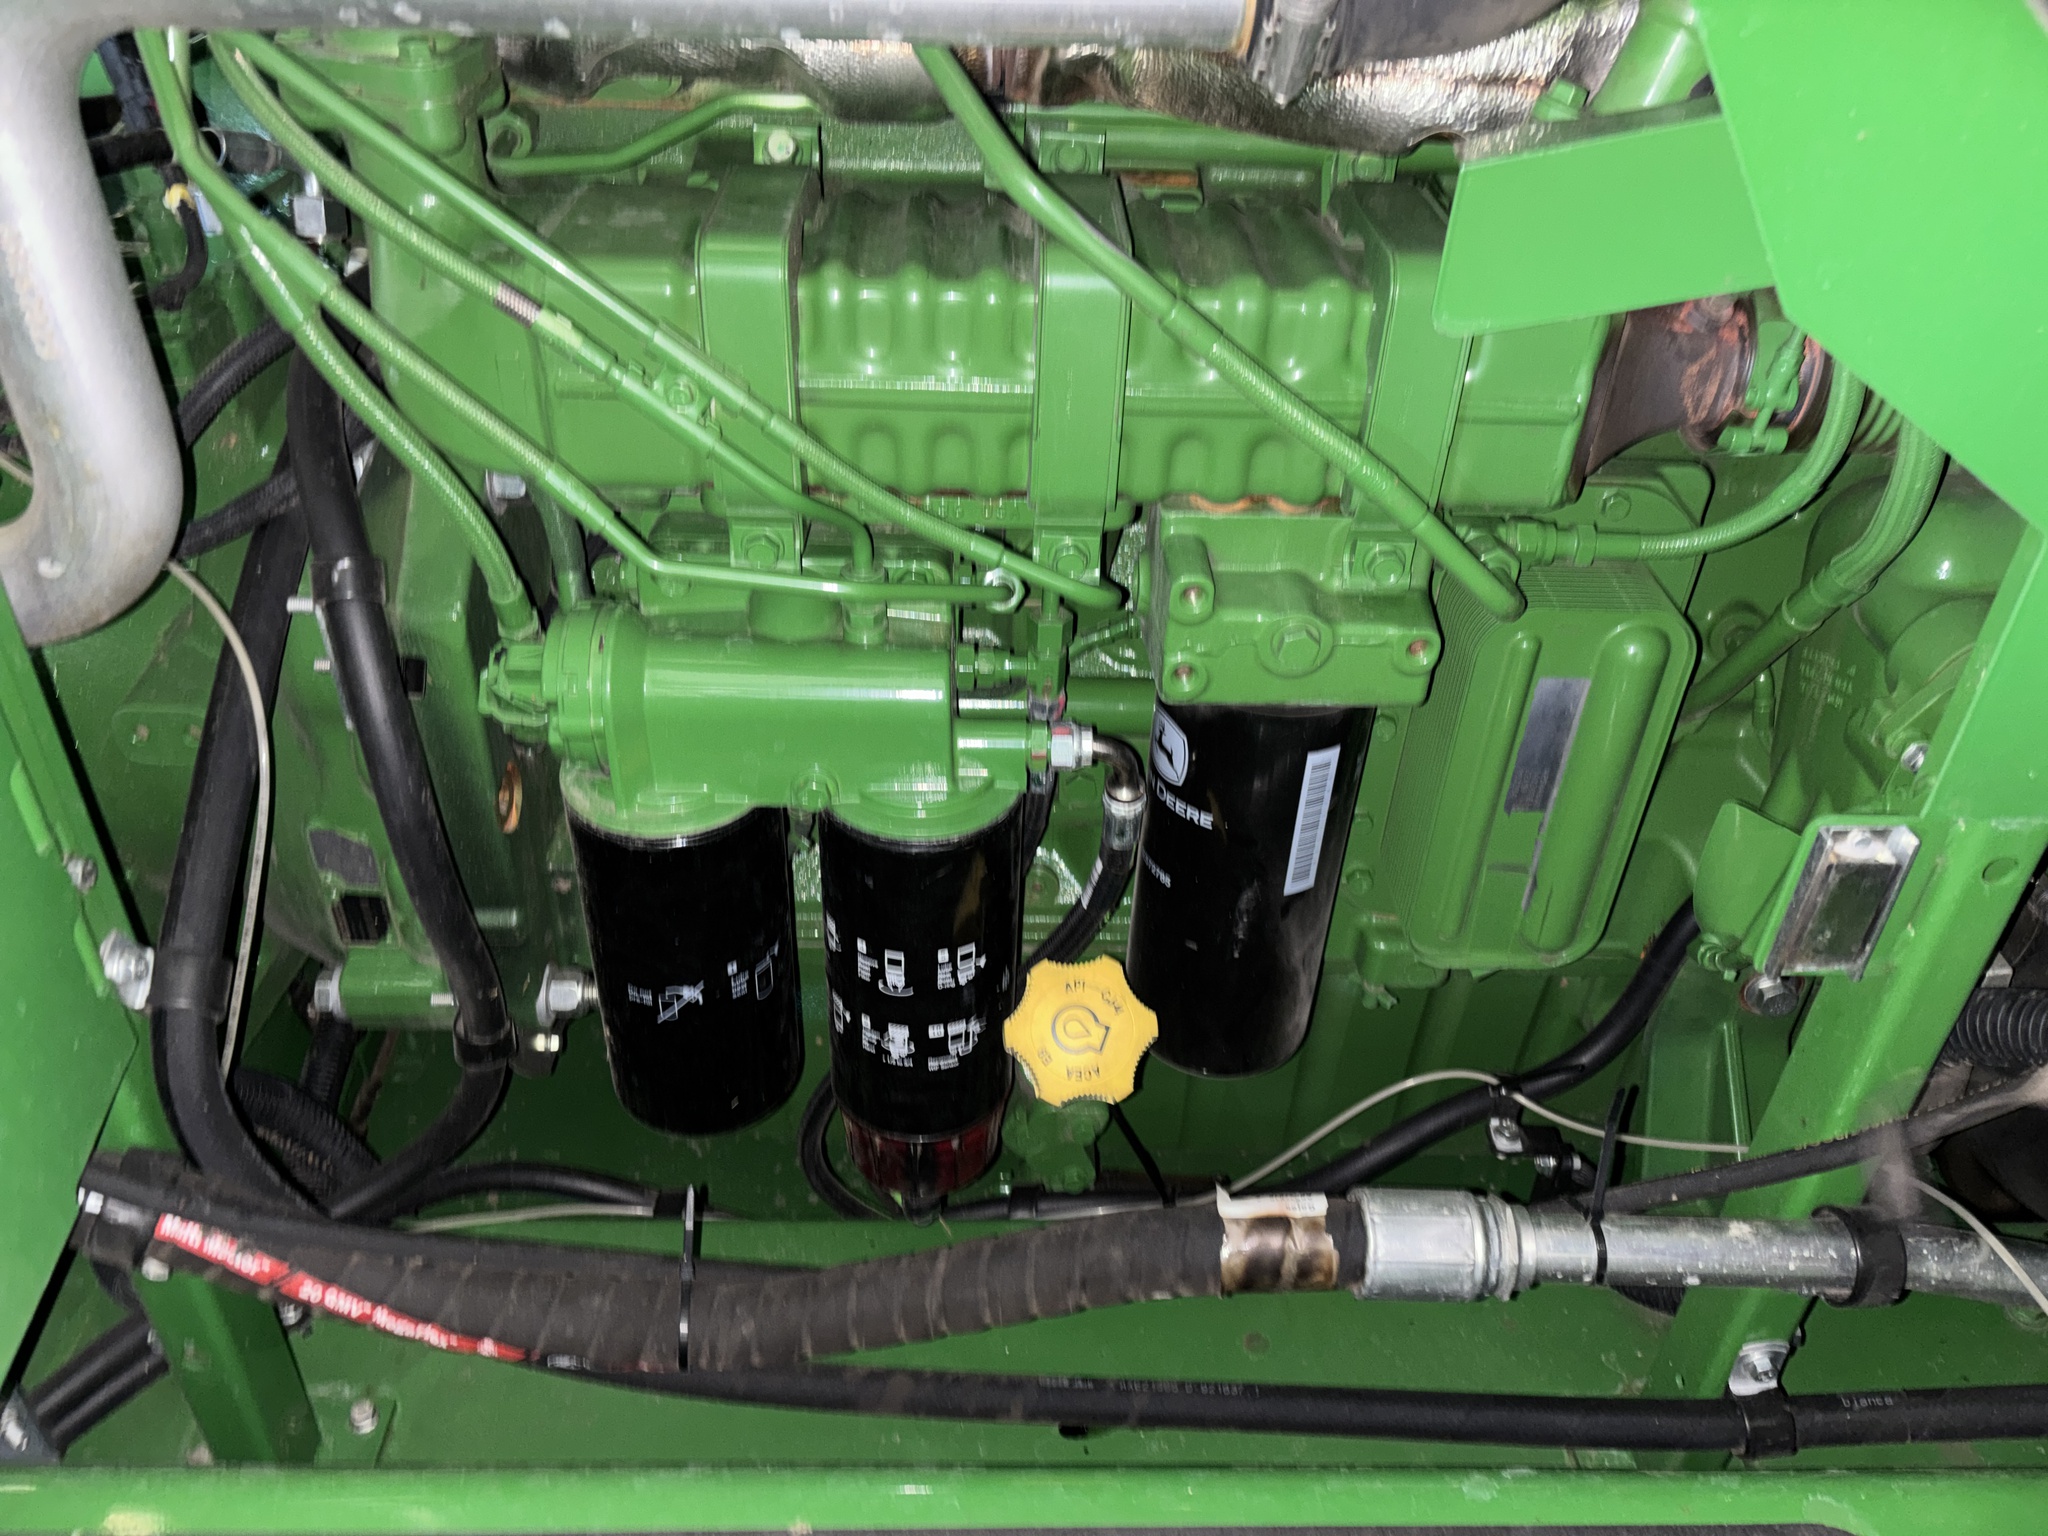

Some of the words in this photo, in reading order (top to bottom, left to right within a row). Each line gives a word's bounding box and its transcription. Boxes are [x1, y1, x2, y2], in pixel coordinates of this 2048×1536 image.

[1156, 784, 1214, 831] DEERE
[1065, 980, 1086, 995] API
[1066, 1064, 1101, 1083] ACEA
